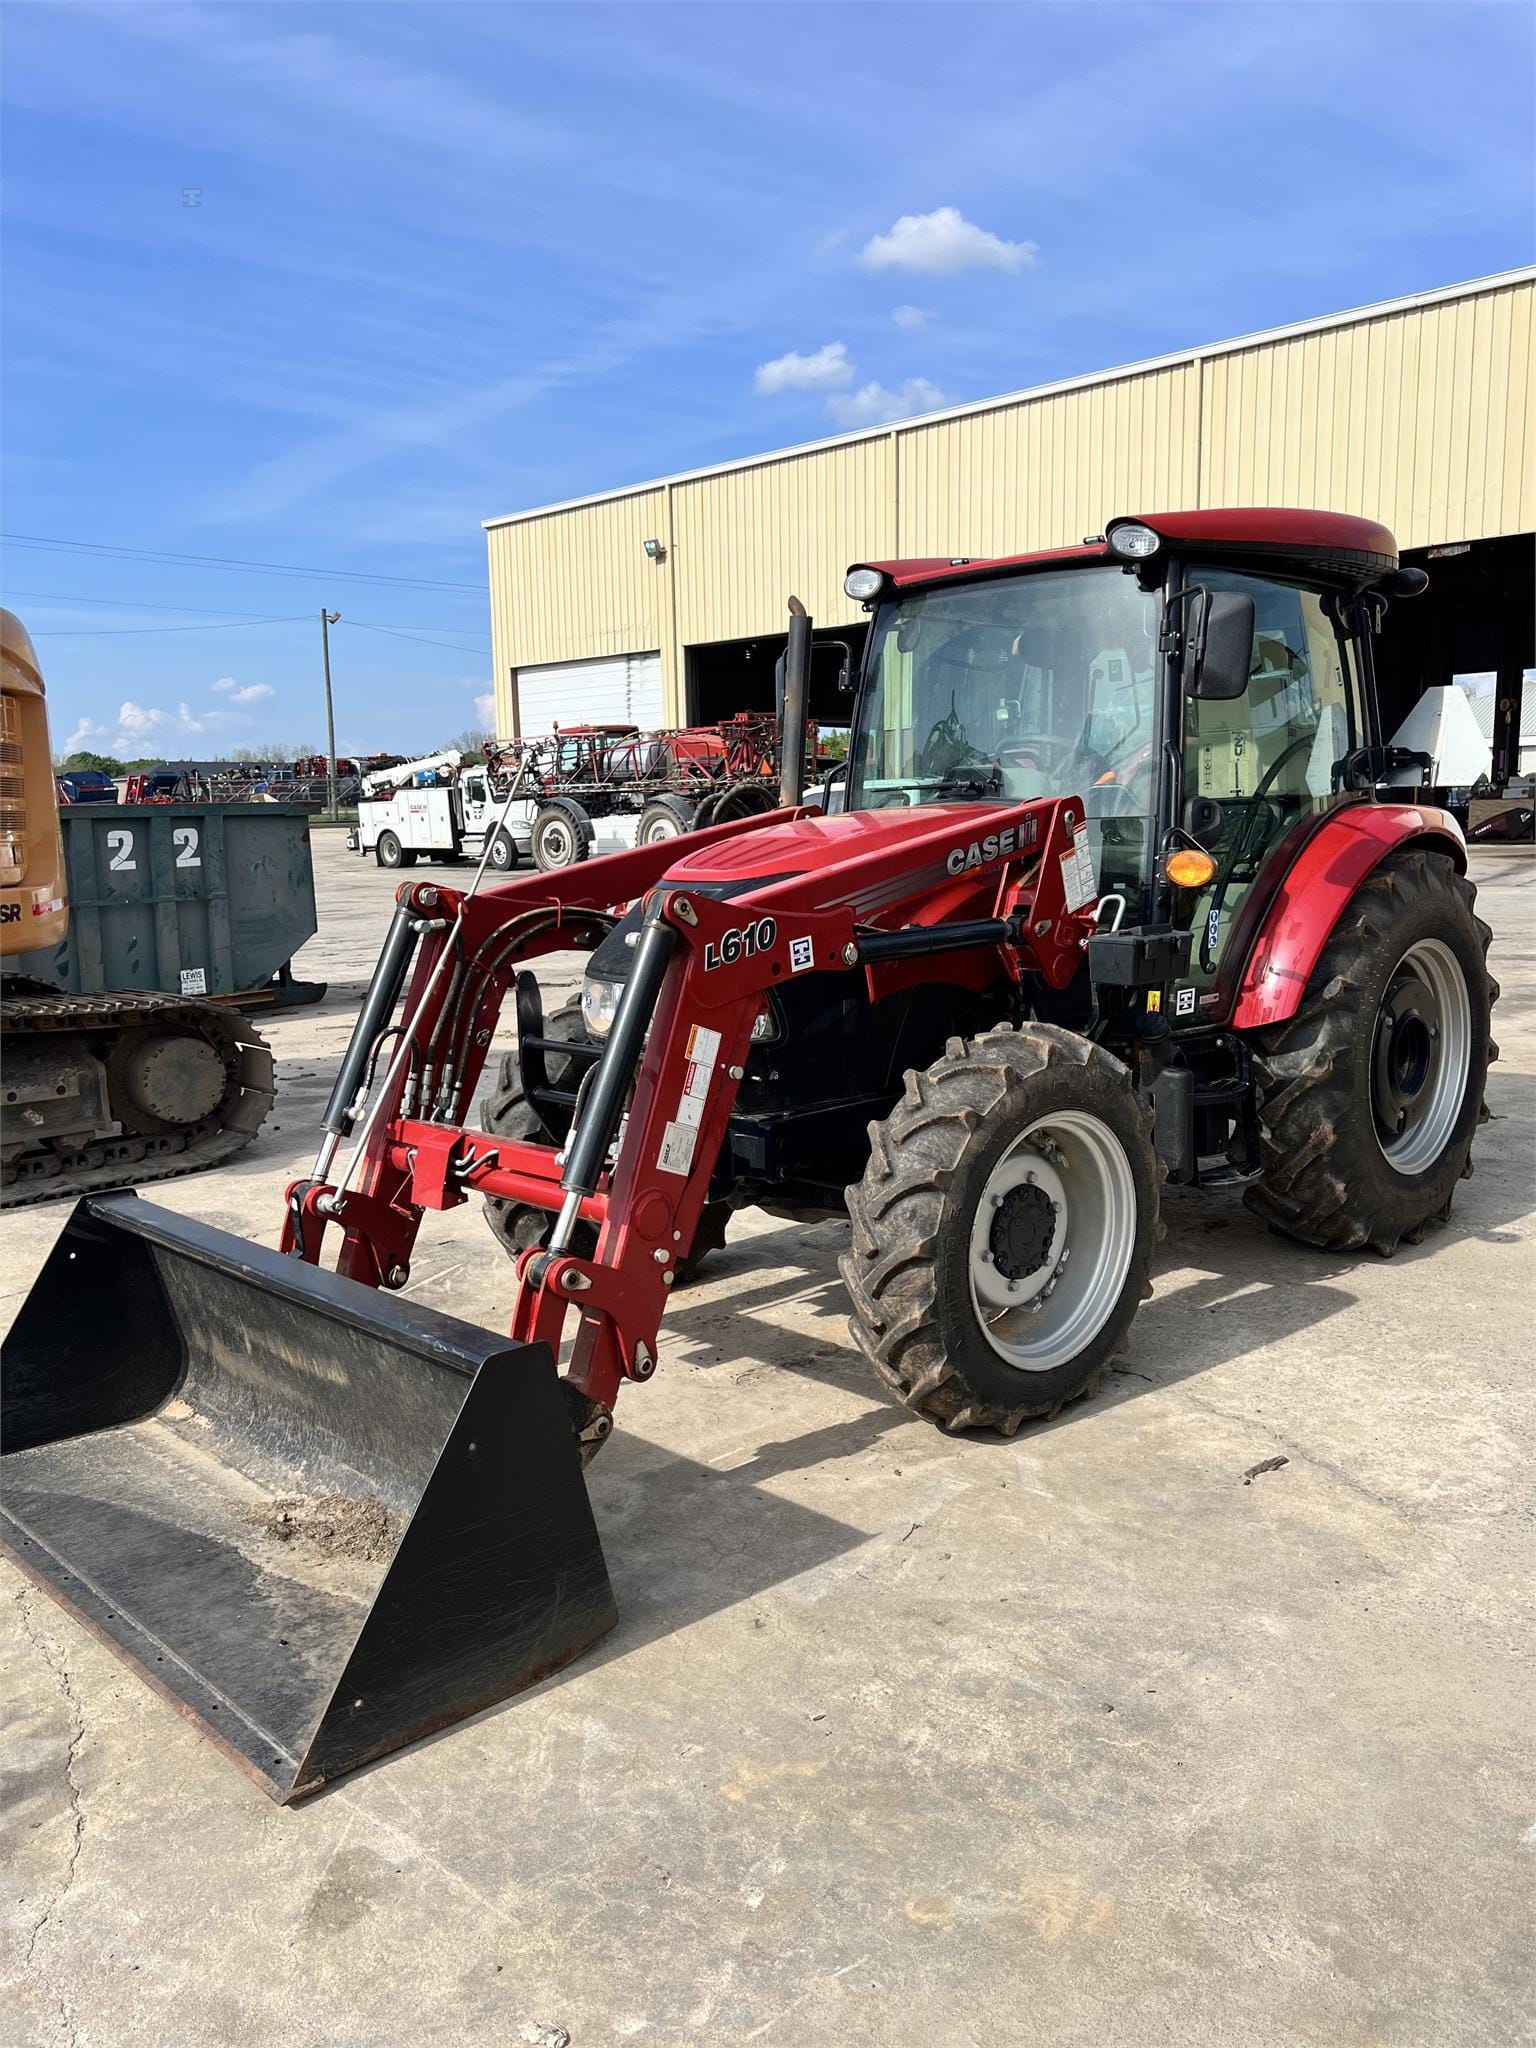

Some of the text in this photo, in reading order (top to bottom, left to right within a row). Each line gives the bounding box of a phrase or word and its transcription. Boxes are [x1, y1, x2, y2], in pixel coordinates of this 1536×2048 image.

[107, 828, 201, 871] 2 2
[947, 828, 1014, 875] CASE
[0, 903, 21, 923] SR
[705, 917, 777, 972] L610
[182, 971, 202, 981] LEWIS
